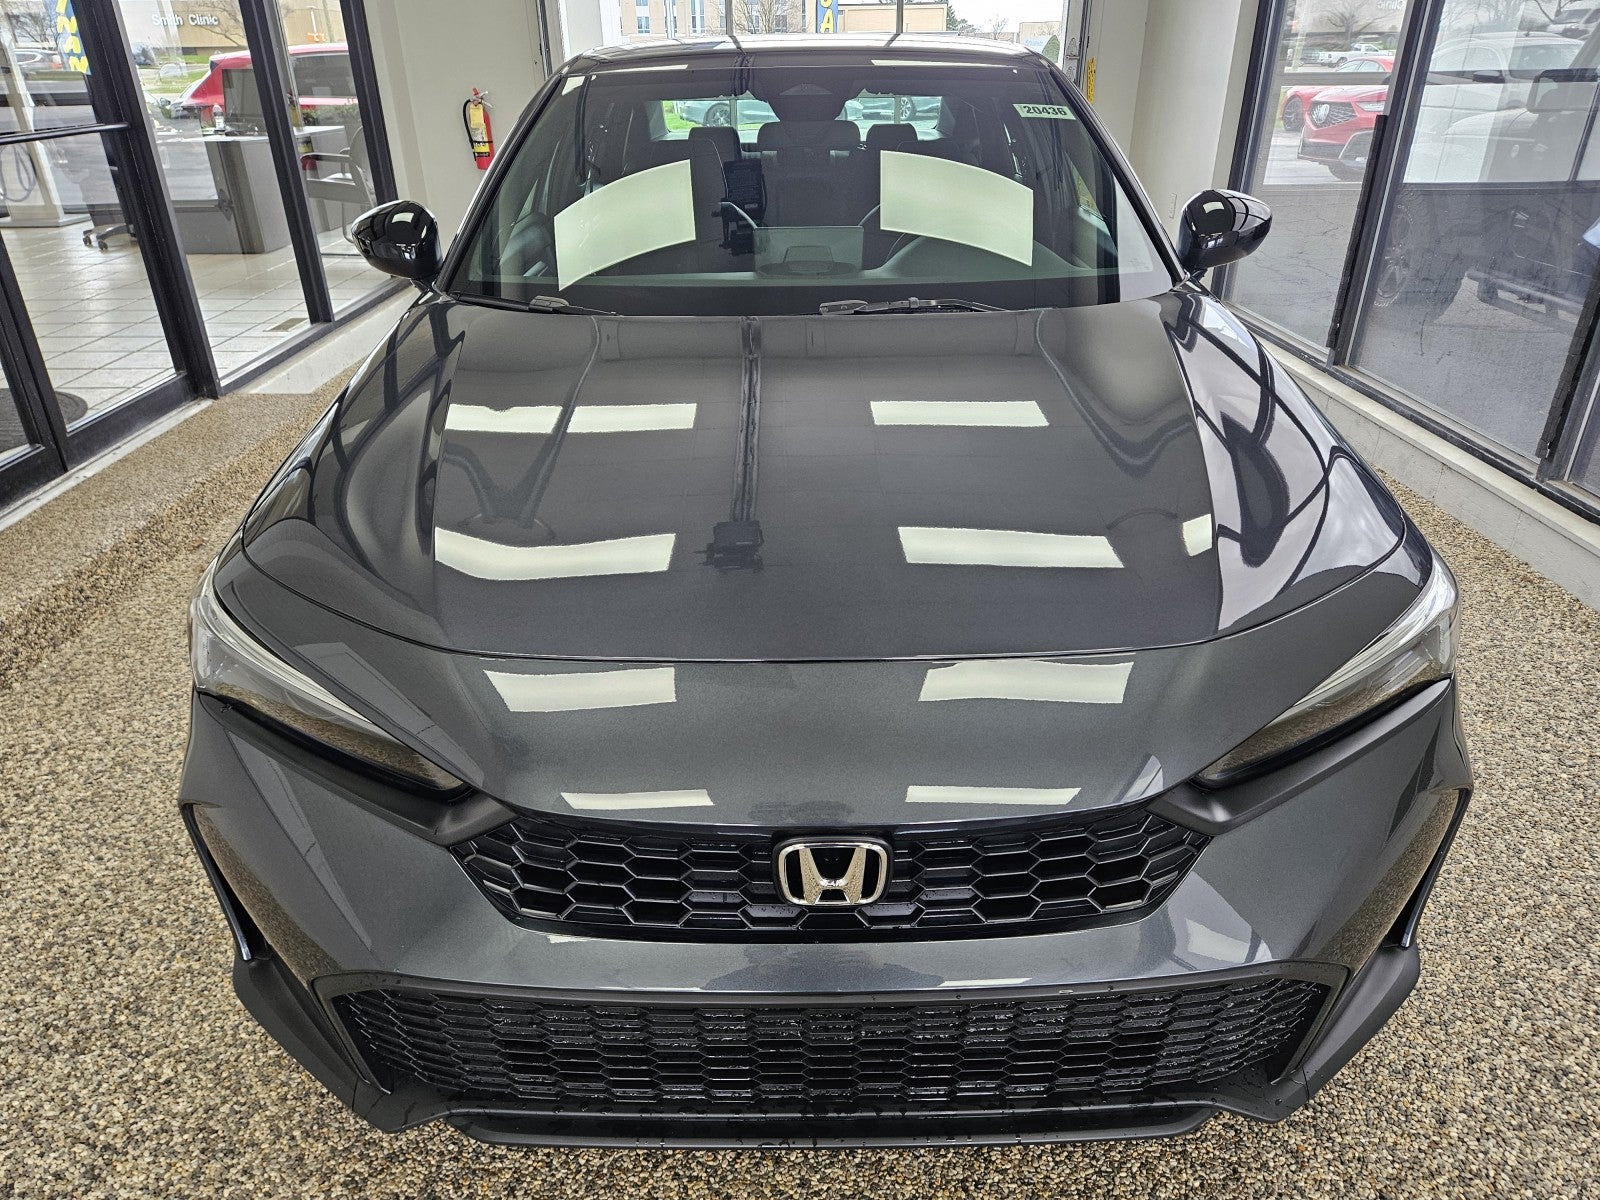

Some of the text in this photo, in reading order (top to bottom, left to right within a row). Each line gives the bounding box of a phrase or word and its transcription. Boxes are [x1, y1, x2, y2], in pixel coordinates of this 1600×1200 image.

[151, 13, 219, 26] Smith Clinic
[1023, 105, 1068, 116] 20436
